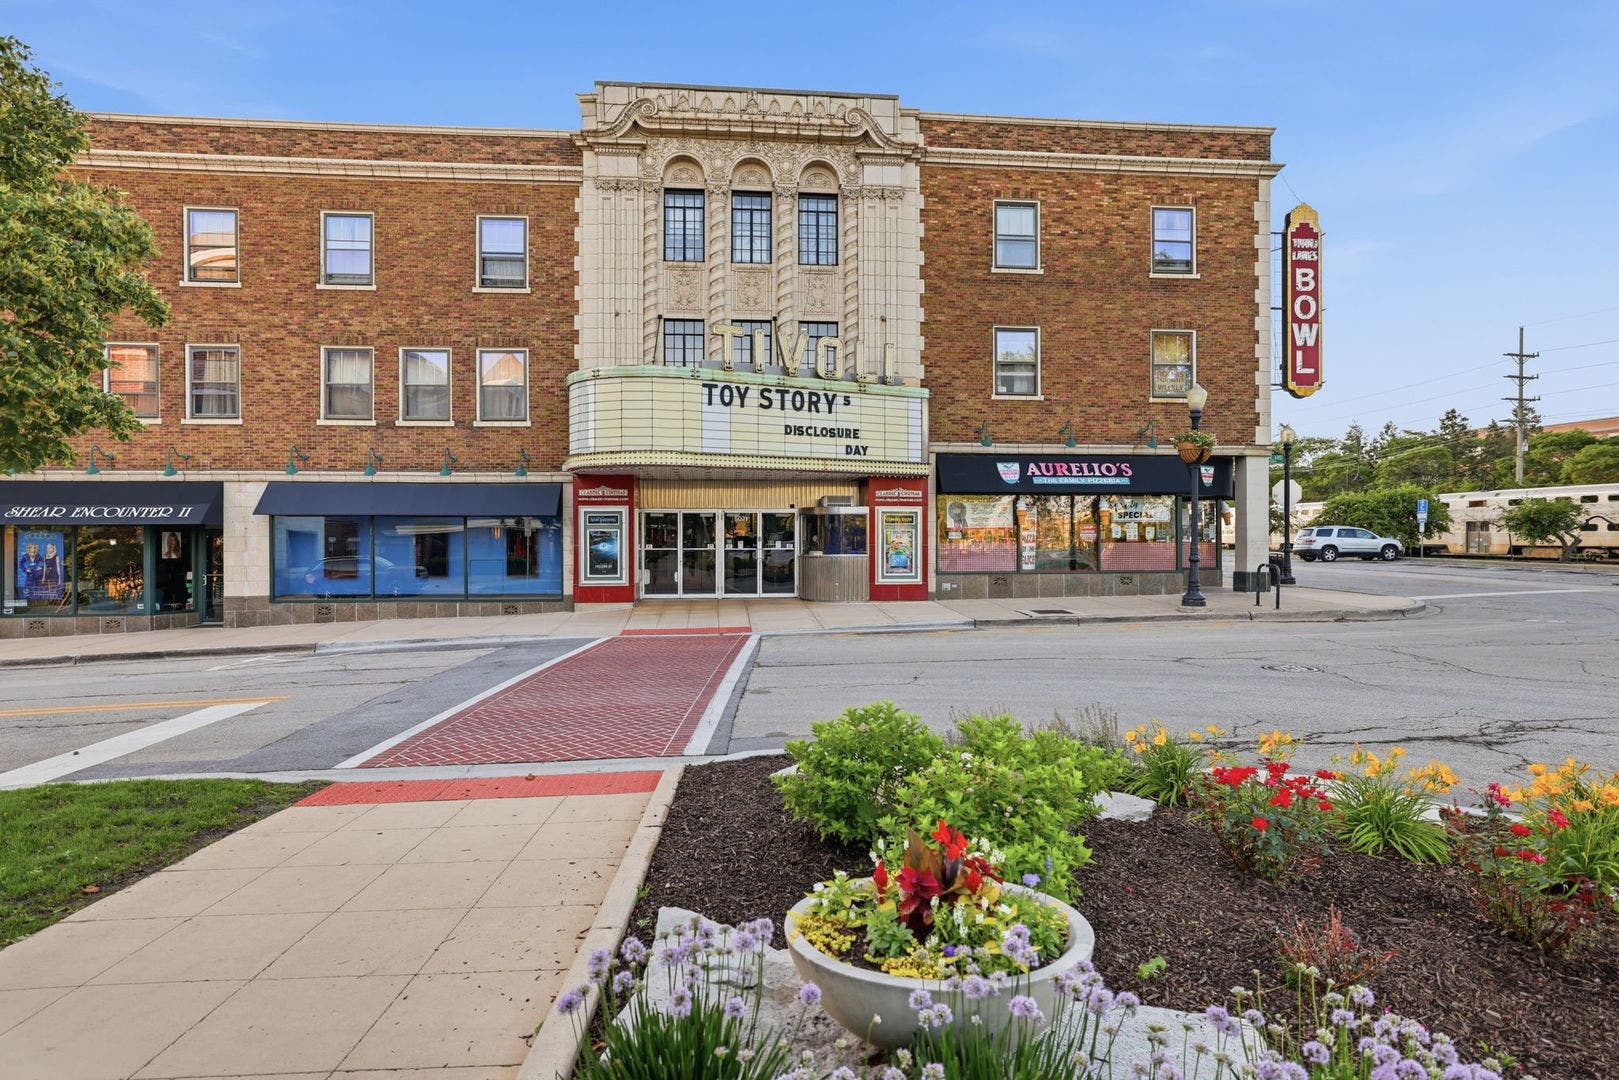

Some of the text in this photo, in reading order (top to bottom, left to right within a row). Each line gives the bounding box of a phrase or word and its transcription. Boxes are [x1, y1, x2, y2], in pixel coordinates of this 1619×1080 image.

[1292, 267, 1318, 374] BOWL
[712, 324, 895, 385] TIVOLI
[701, 383, 851, 415] TOY STORY 5
[784, 424, 860, 439] DISCLOSURE
[845, 445, 868, 456] DAY
[1027, 462, 1133, 476] AURELIO'S
[4, 506, 193, 518] SHEAR ENCOUNTER II
[1118, 511, 1154, 519] SPECIAL
